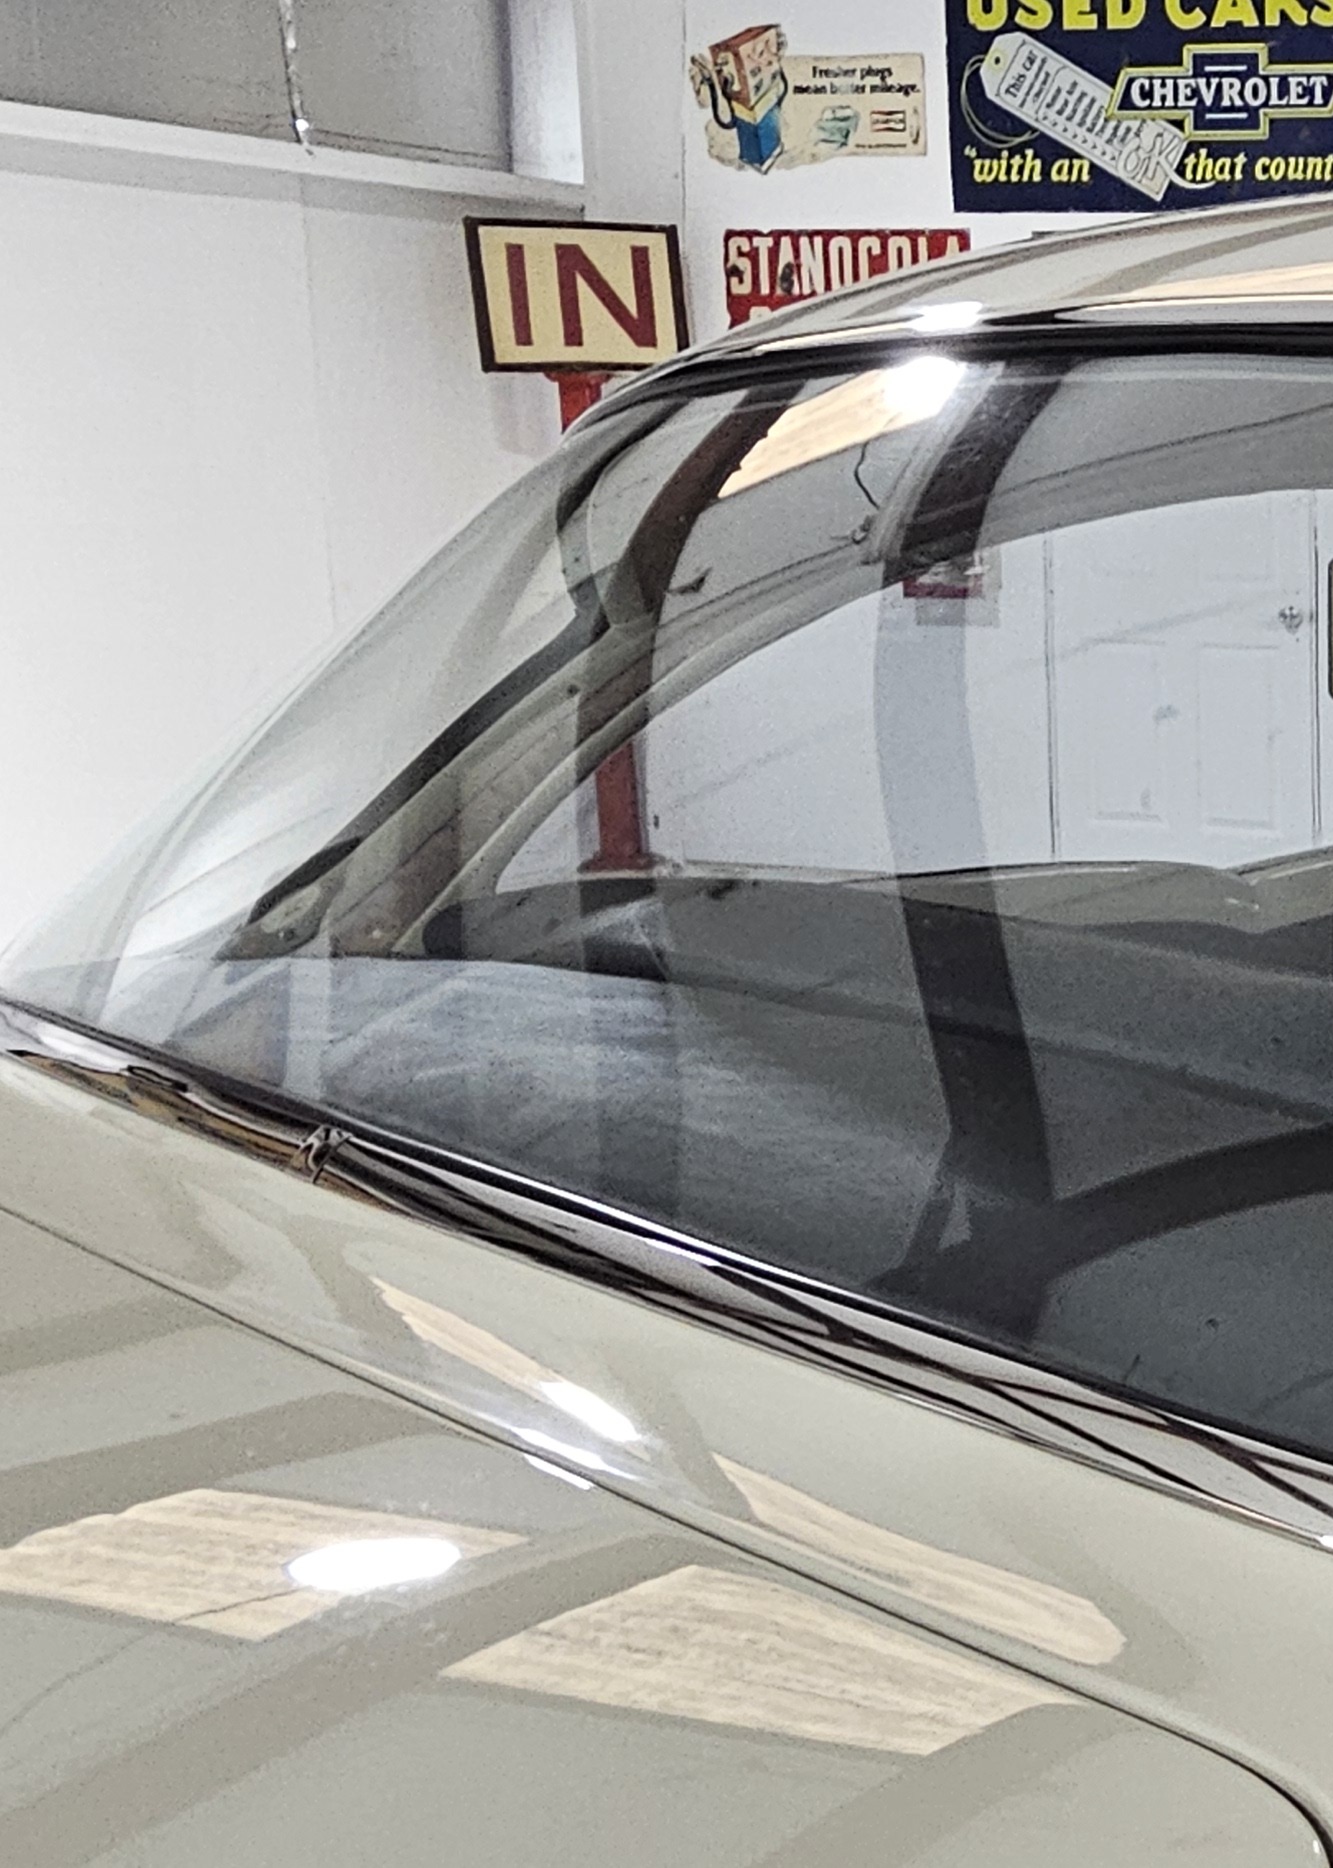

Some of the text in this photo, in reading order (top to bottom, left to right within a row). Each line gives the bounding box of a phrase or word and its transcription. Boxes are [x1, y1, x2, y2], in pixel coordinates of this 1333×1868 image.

[1004, 72, 1027, 99] This
[1022, 49, 1038, 72] car
[1130, 76, 1328, 108] CHEVROLET
[1050, 158, 1091, 182] an
[1184, 148, 1248, 182] that
[504, 242, 658, 348] IN
